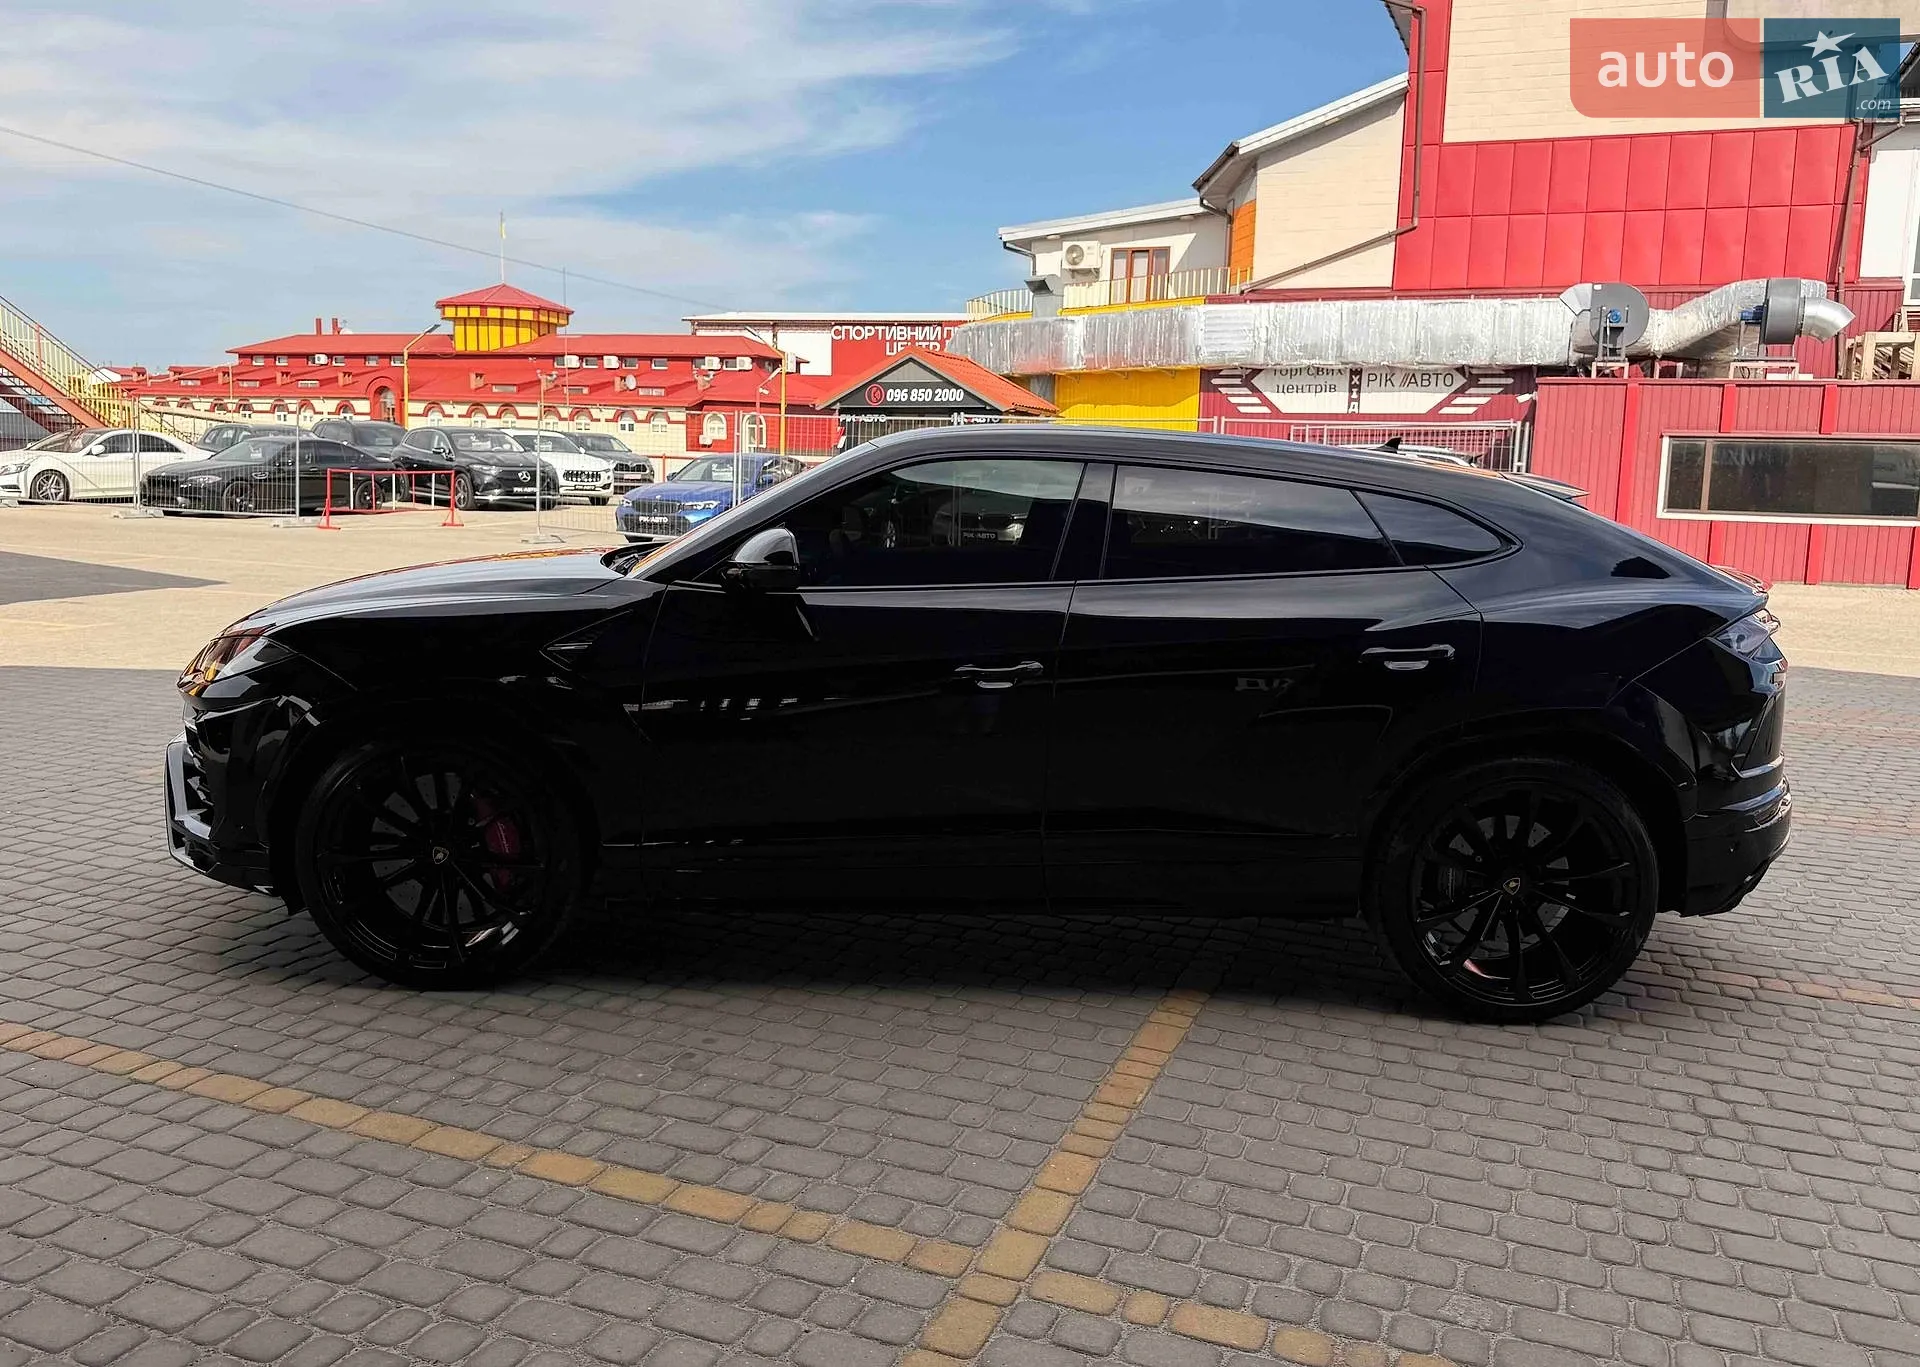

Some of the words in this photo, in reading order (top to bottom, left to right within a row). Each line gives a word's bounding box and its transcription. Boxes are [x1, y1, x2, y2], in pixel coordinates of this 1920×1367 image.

[831, 324, 942, 341] СПОРТИВНИЙ
[1367, 373, 1395, 388] РІК
[886, 388, 909, 402] 096
[910, 388, 933, 402] 850
[934, 388, 965, 402] 2000
[1276, 381, 1337, 397] центрів
